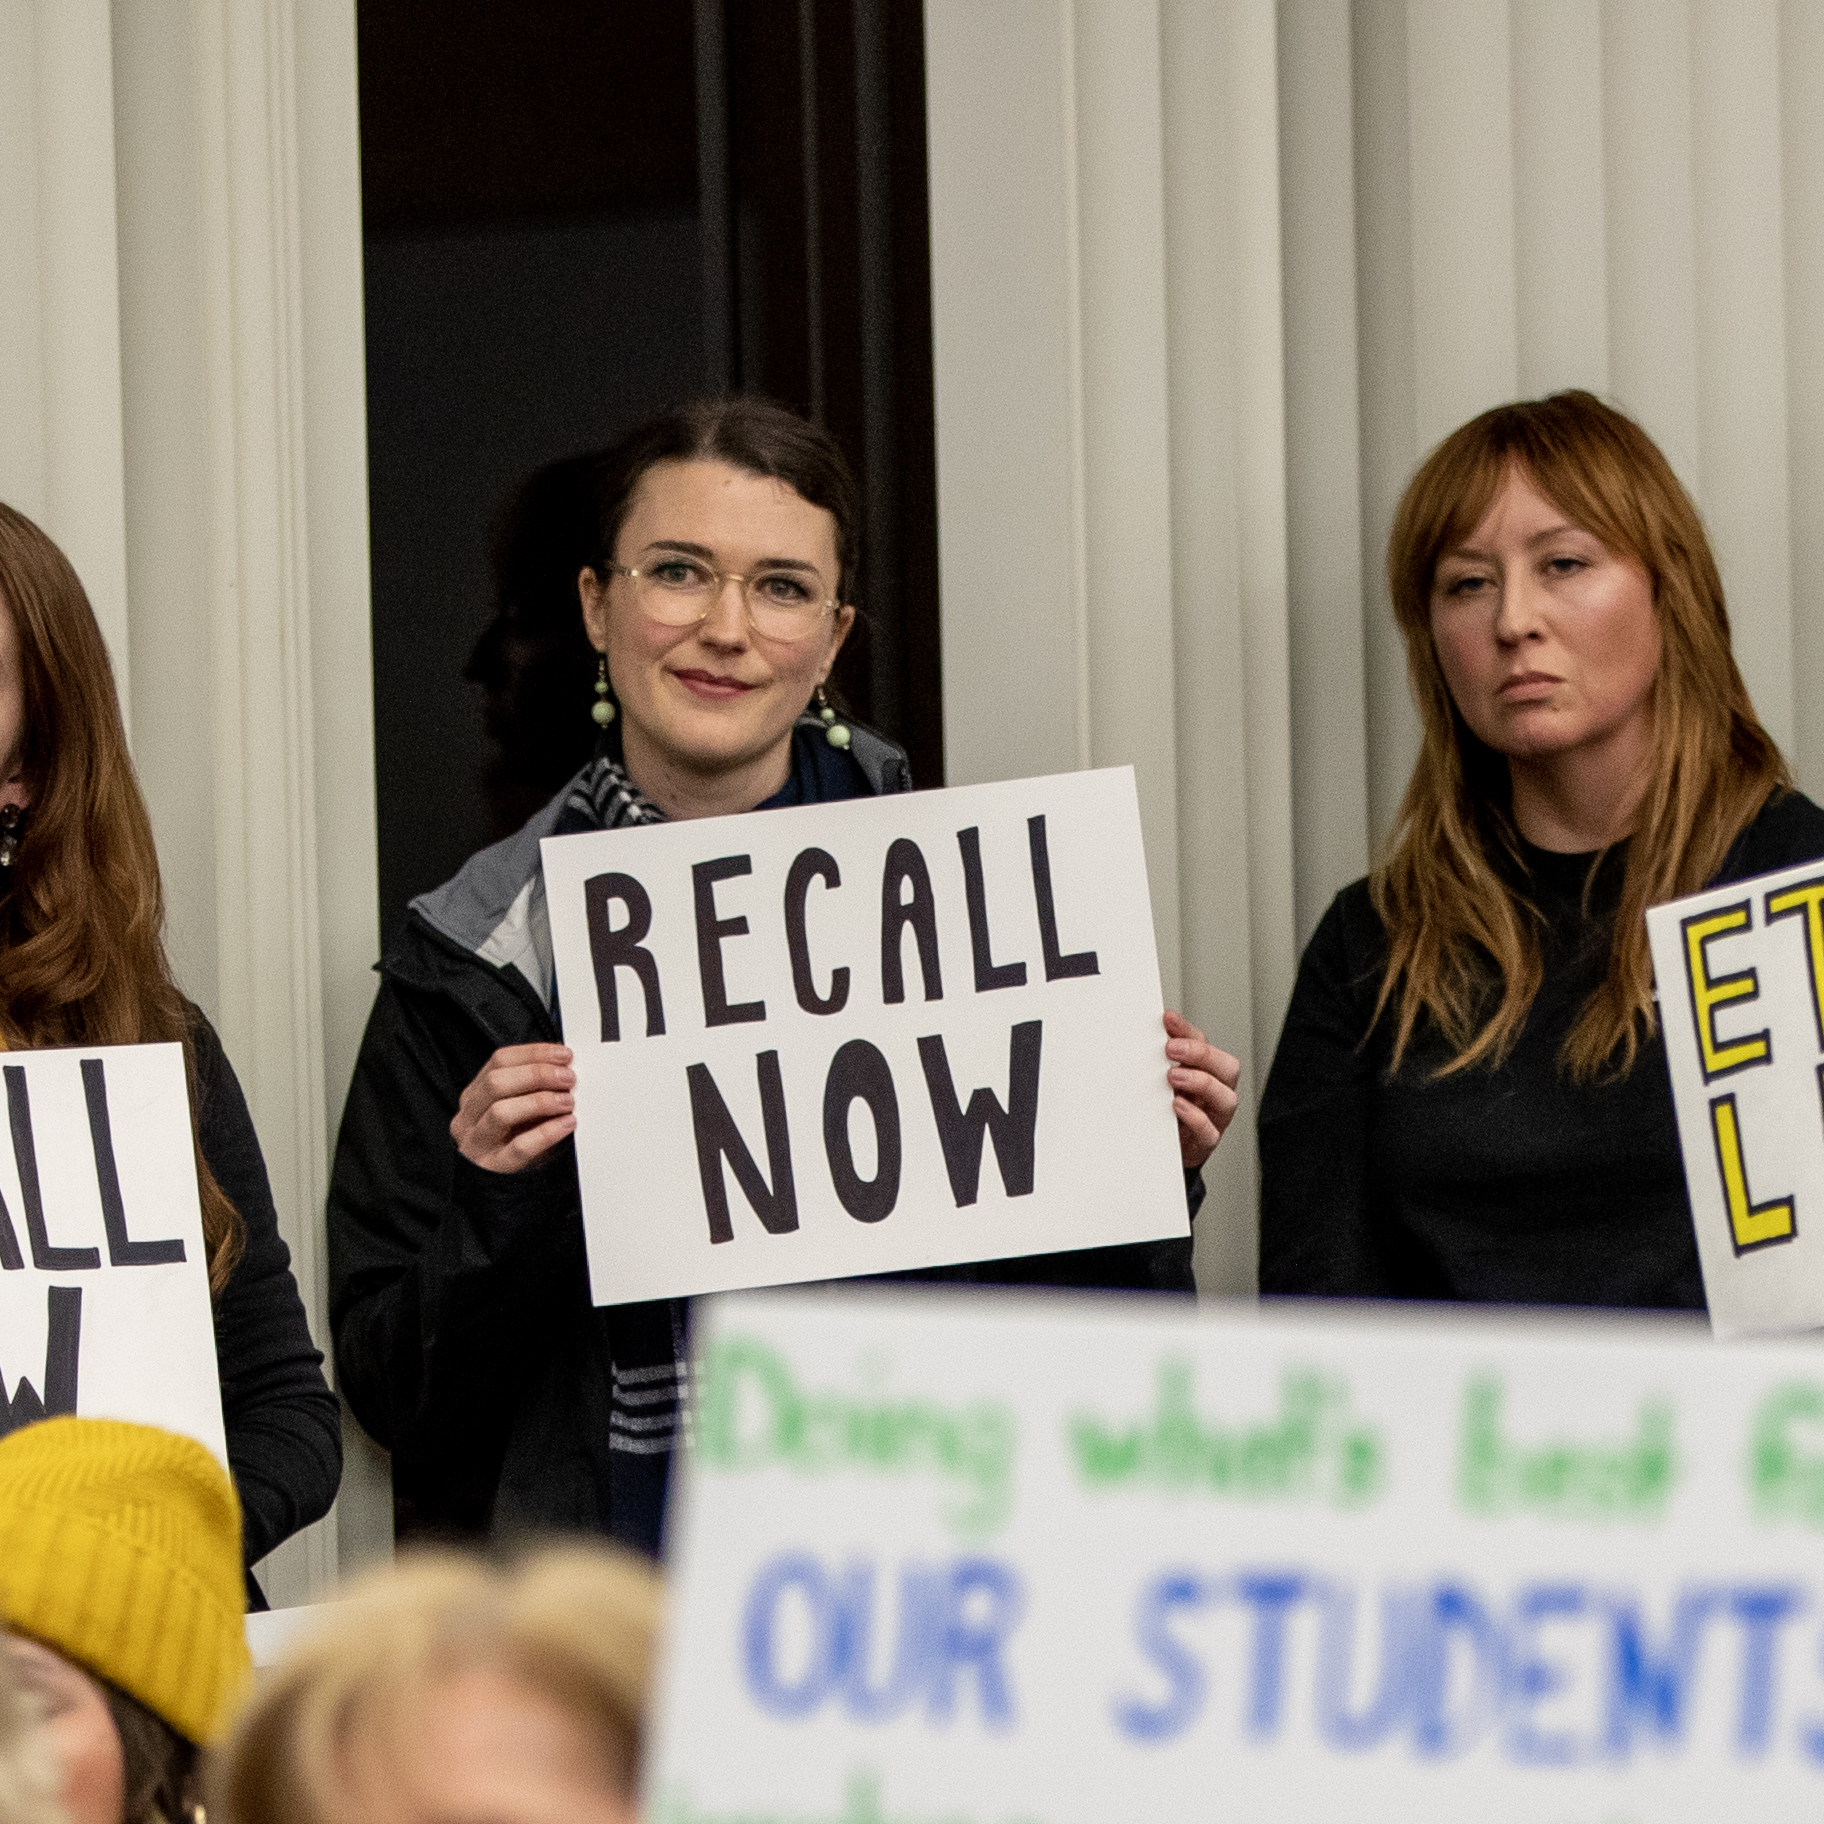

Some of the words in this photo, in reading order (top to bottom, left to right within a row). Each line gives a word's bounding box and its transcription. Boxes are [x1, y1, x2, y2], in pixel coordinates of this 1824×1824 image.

[584, 814, 1101, 1043] RECALL
[686, 1019, 1043, 1245] NOW
[696, 1331, 1016, 1540] Doing
[1455, 1369, 1671, 1524] best
[738, 1547, 1024, 1734] OUR
